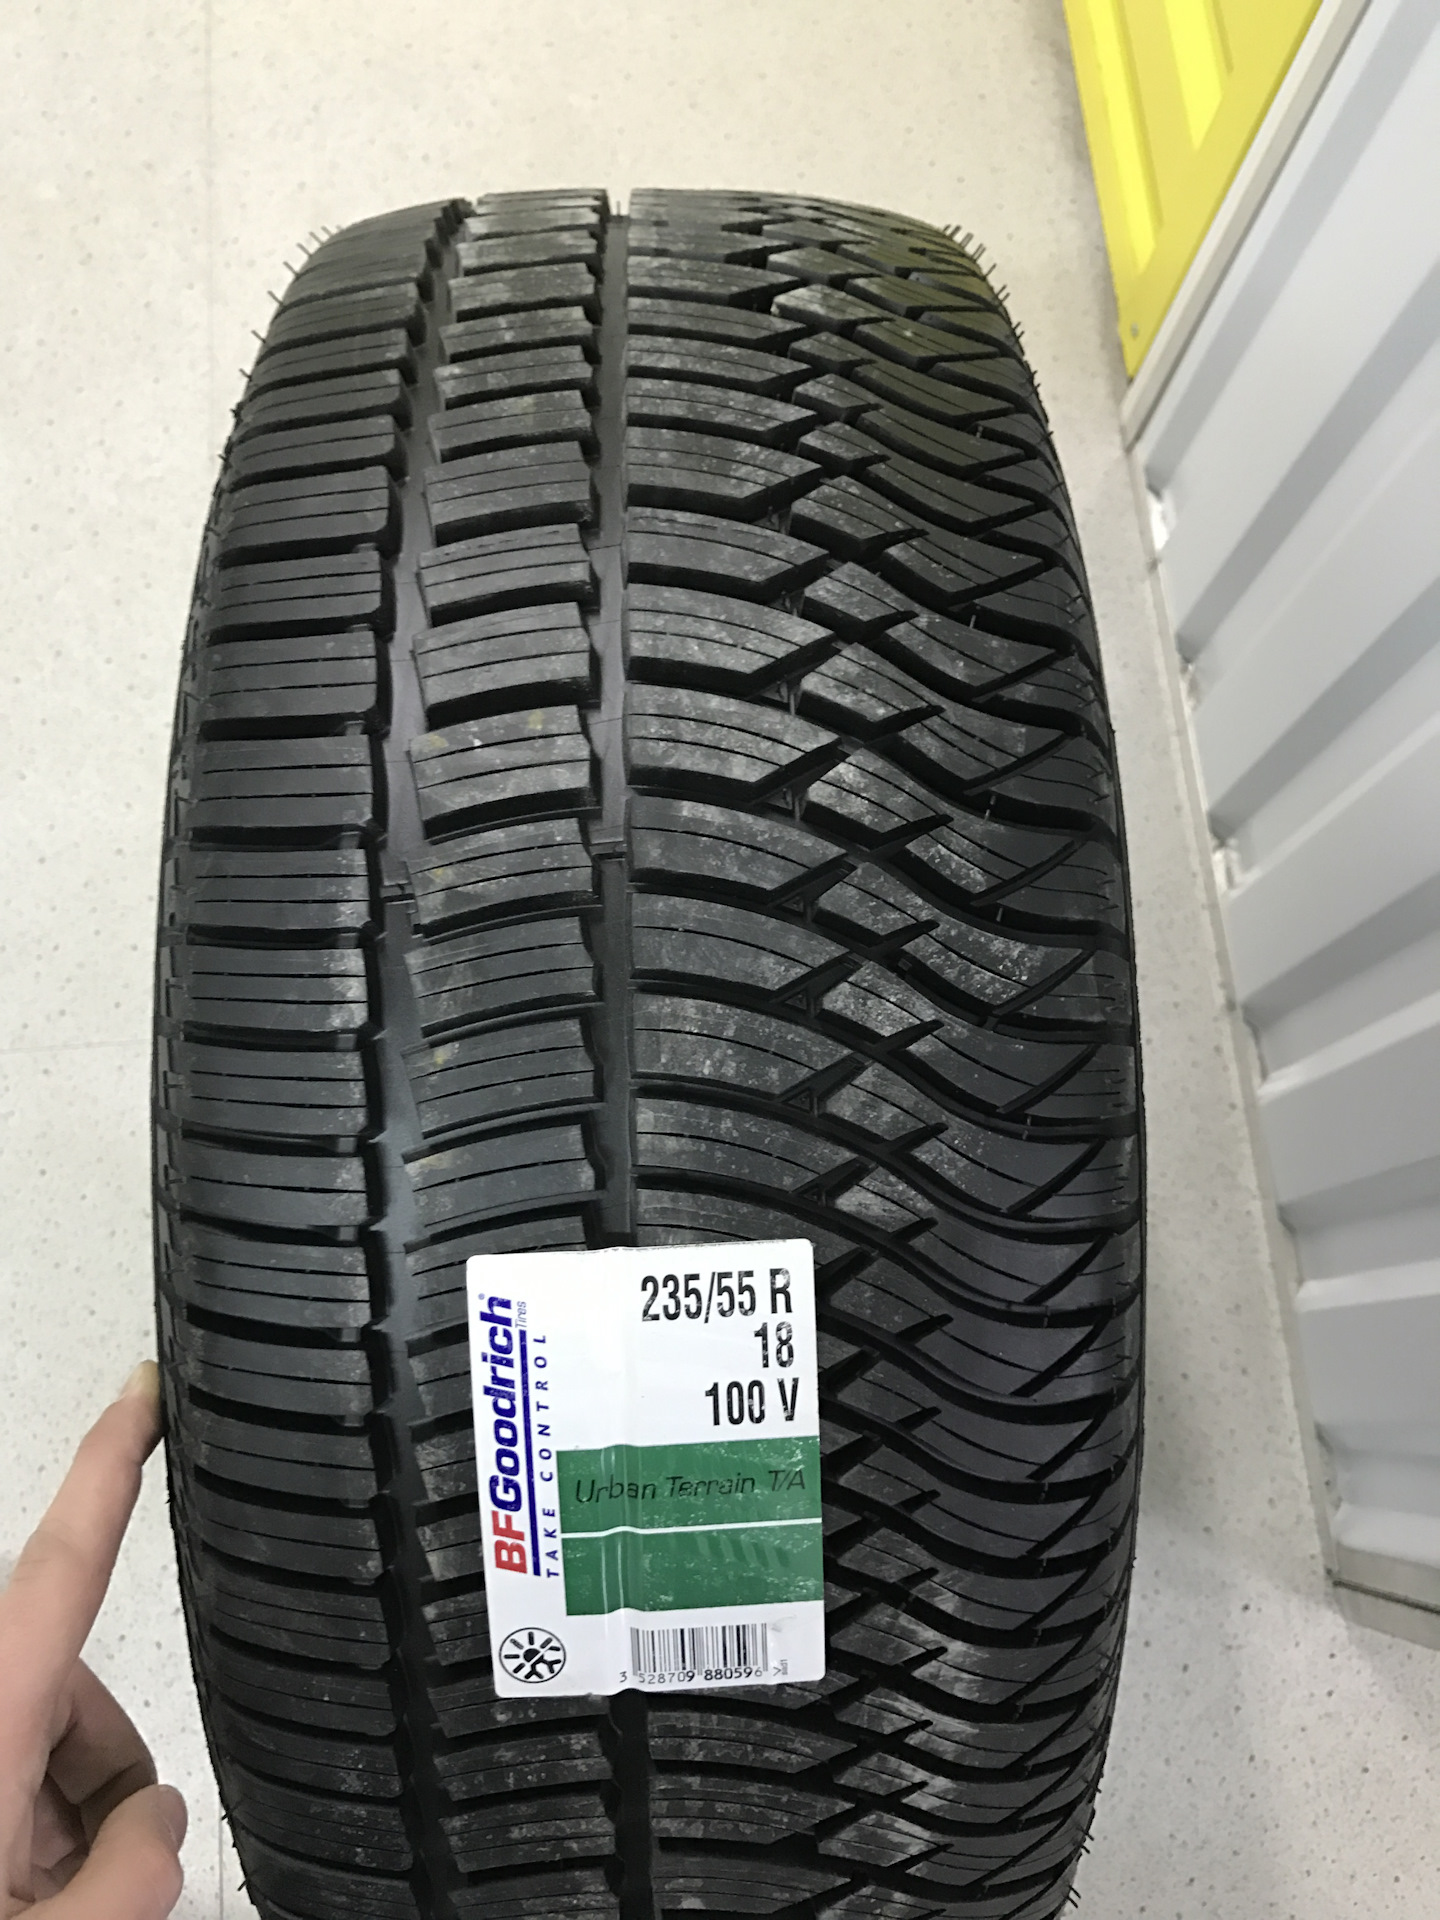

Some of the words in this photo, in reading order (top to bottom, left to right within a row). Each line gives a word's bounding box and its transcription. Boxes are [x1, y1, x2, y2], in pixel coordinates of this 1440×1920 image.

[515, 1301, 527, 1328] Tires
[641, 1270, 757, 1323] 235/55
[769, 1268, 793, 1314] R
[754, 1321, 794, 1368] 18
[533, 1335, 554, 1482] CONTROL
[705, 1380, 765, 1425] 100
[777, 1377, 799, 1421] V
[480, 1296, 527, 1574] BFGoodrich
[575, 1474, 656, 1503] Urban
[666, 1472, 755, 1498] Terrain
[768, 1469, 806, 1492] T/A
[542, 1508, 560, 1578] TAKE
[619, 1671, 628, 1683] 3
[638, 1670, 695, 1684] 528709
[704, 1667, 763, 1681] 880596
